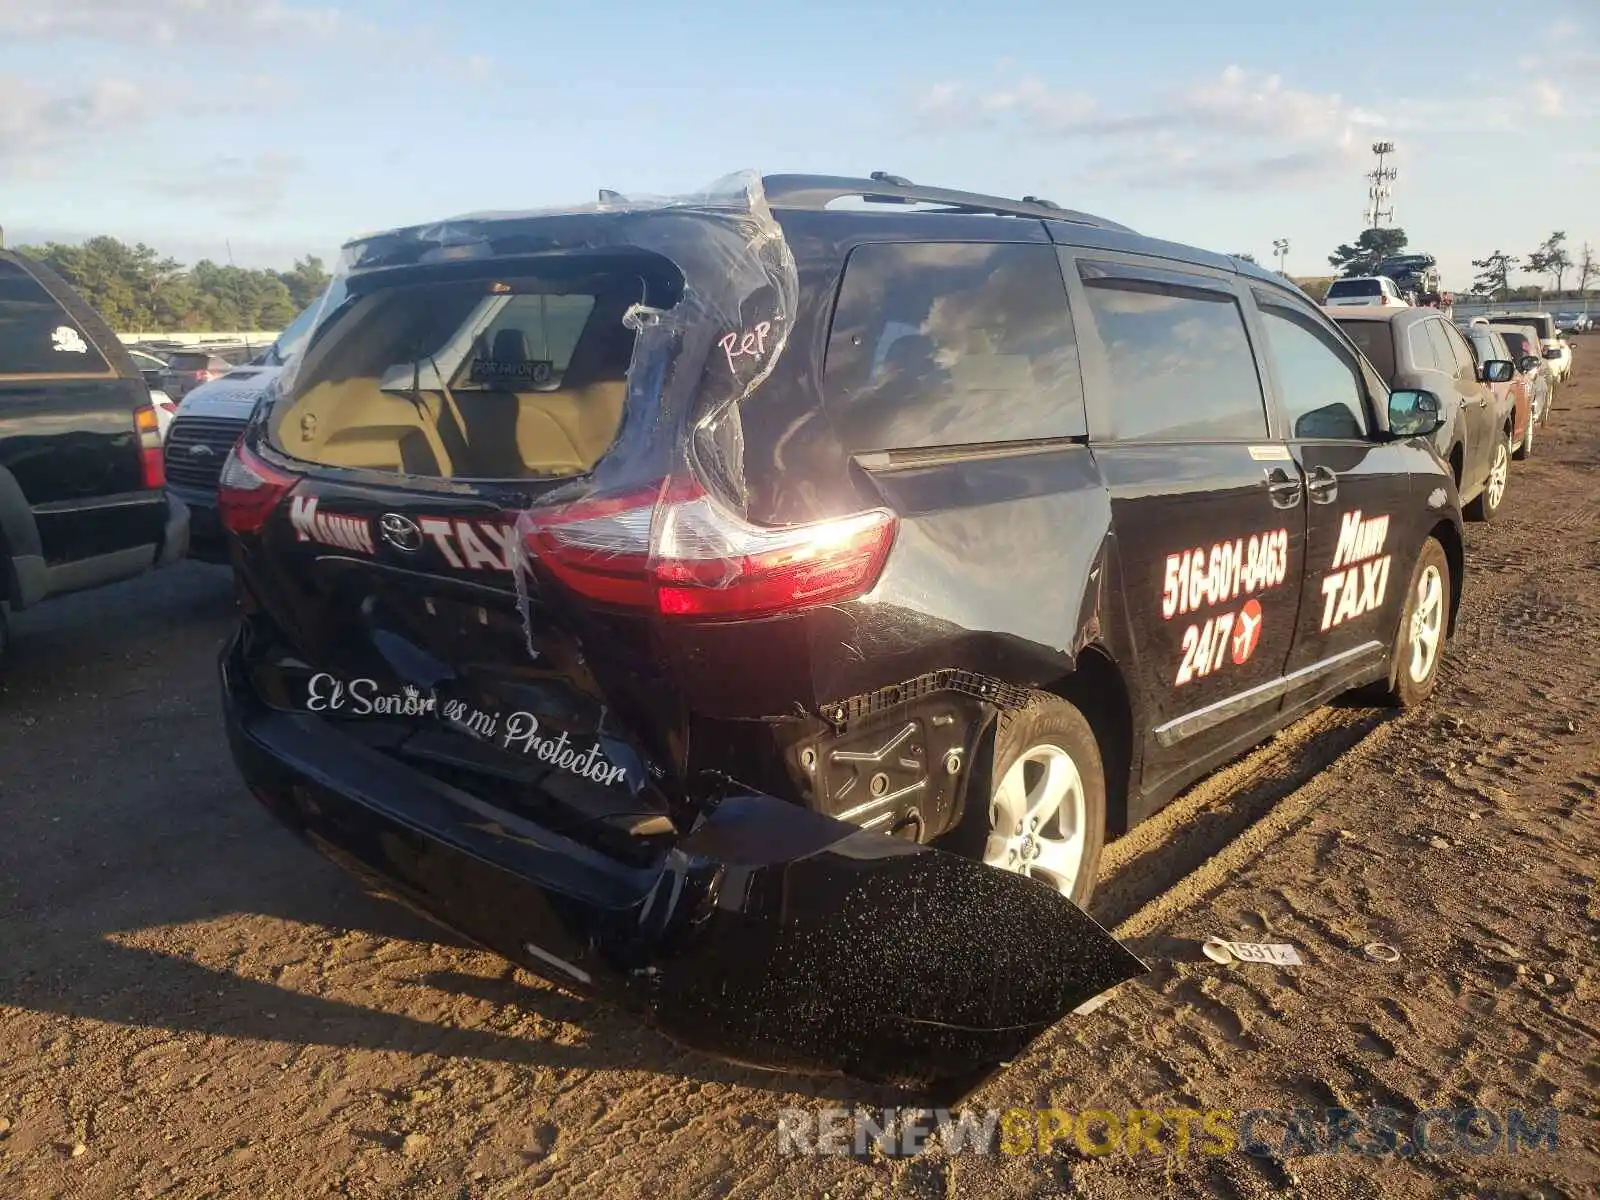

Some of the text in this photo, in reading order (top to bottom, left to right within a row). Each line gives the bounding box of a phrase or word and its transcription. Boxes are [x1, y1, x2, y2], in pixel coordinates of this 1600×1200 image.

[418, 515, 523, 570] TAX
[1321, 555, 1392, 633] TAXI
[1174, 612, 1235, 687] 24/7
[306, 673, 627, 786] El Señor es mi Protector
